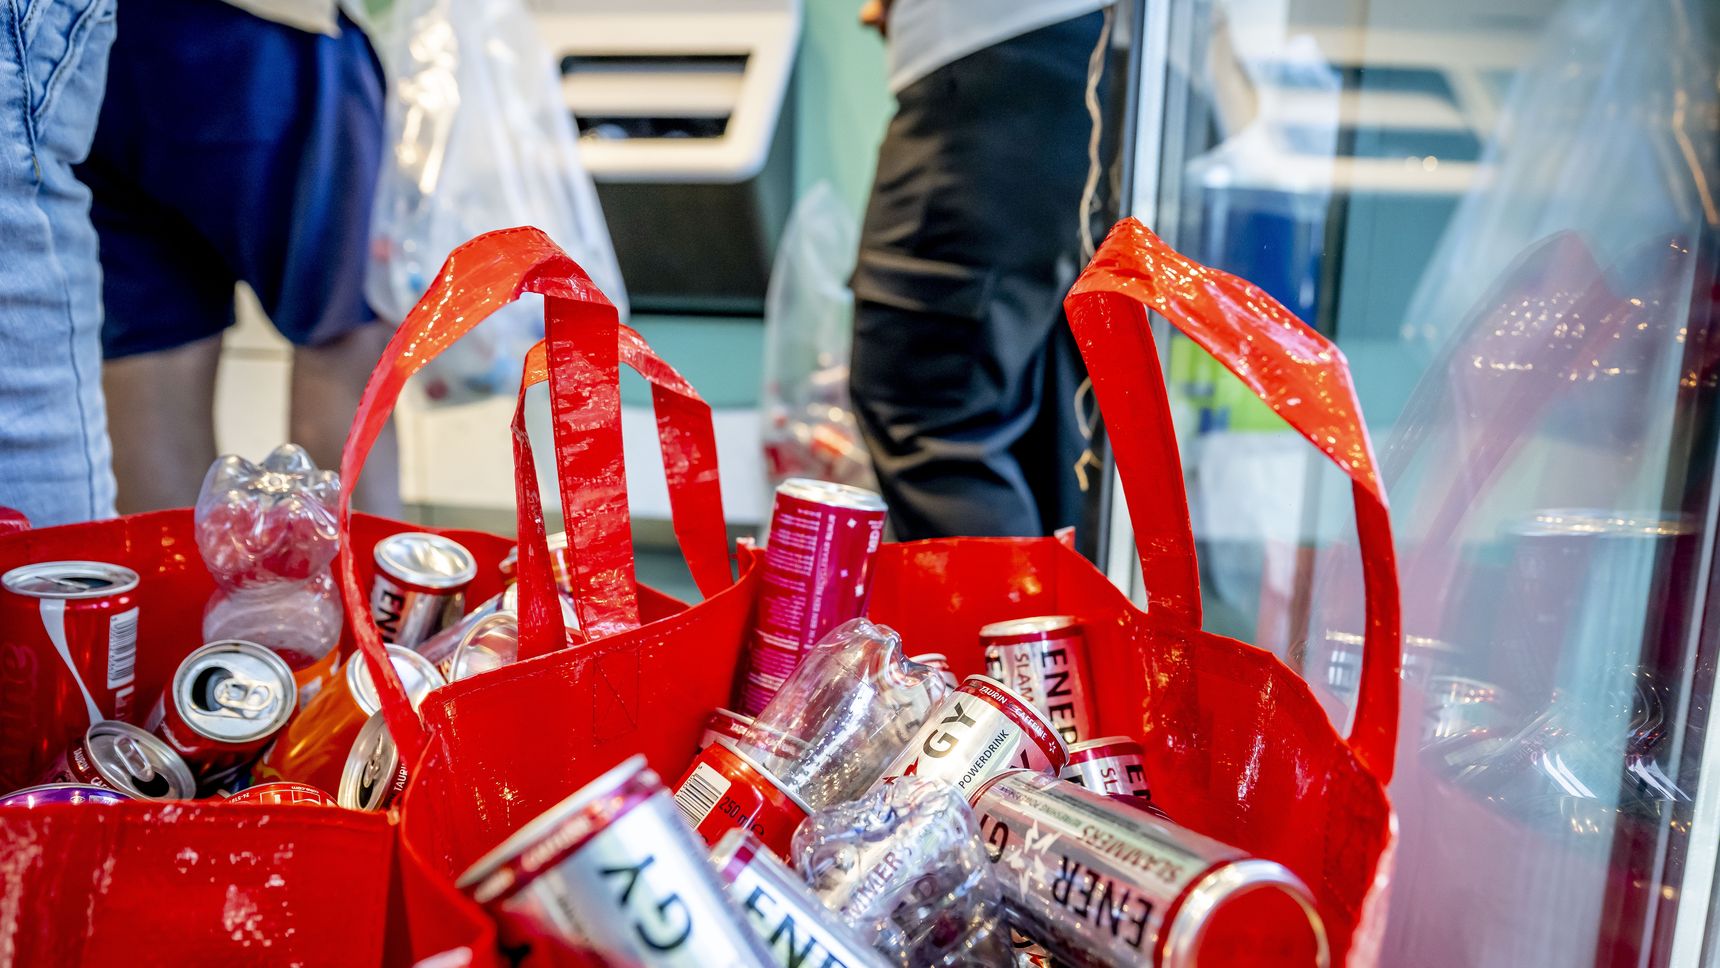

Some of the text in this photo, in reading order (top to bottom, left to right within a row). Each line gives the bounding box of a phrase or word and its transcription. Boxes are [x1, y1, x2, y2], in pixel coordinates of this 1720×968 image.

[922, 701, 977, 759] GY
[980, 684, 1048, 741] TAURIN CAFFEINE
[958, 729, 1010, 790] POWERDRINK
[719, 796, 740, 818] 250
[597, 854, 693, 951] GY
[744, 885, 850, 968] EN
[1052, 854, 1154, 949] ENER
